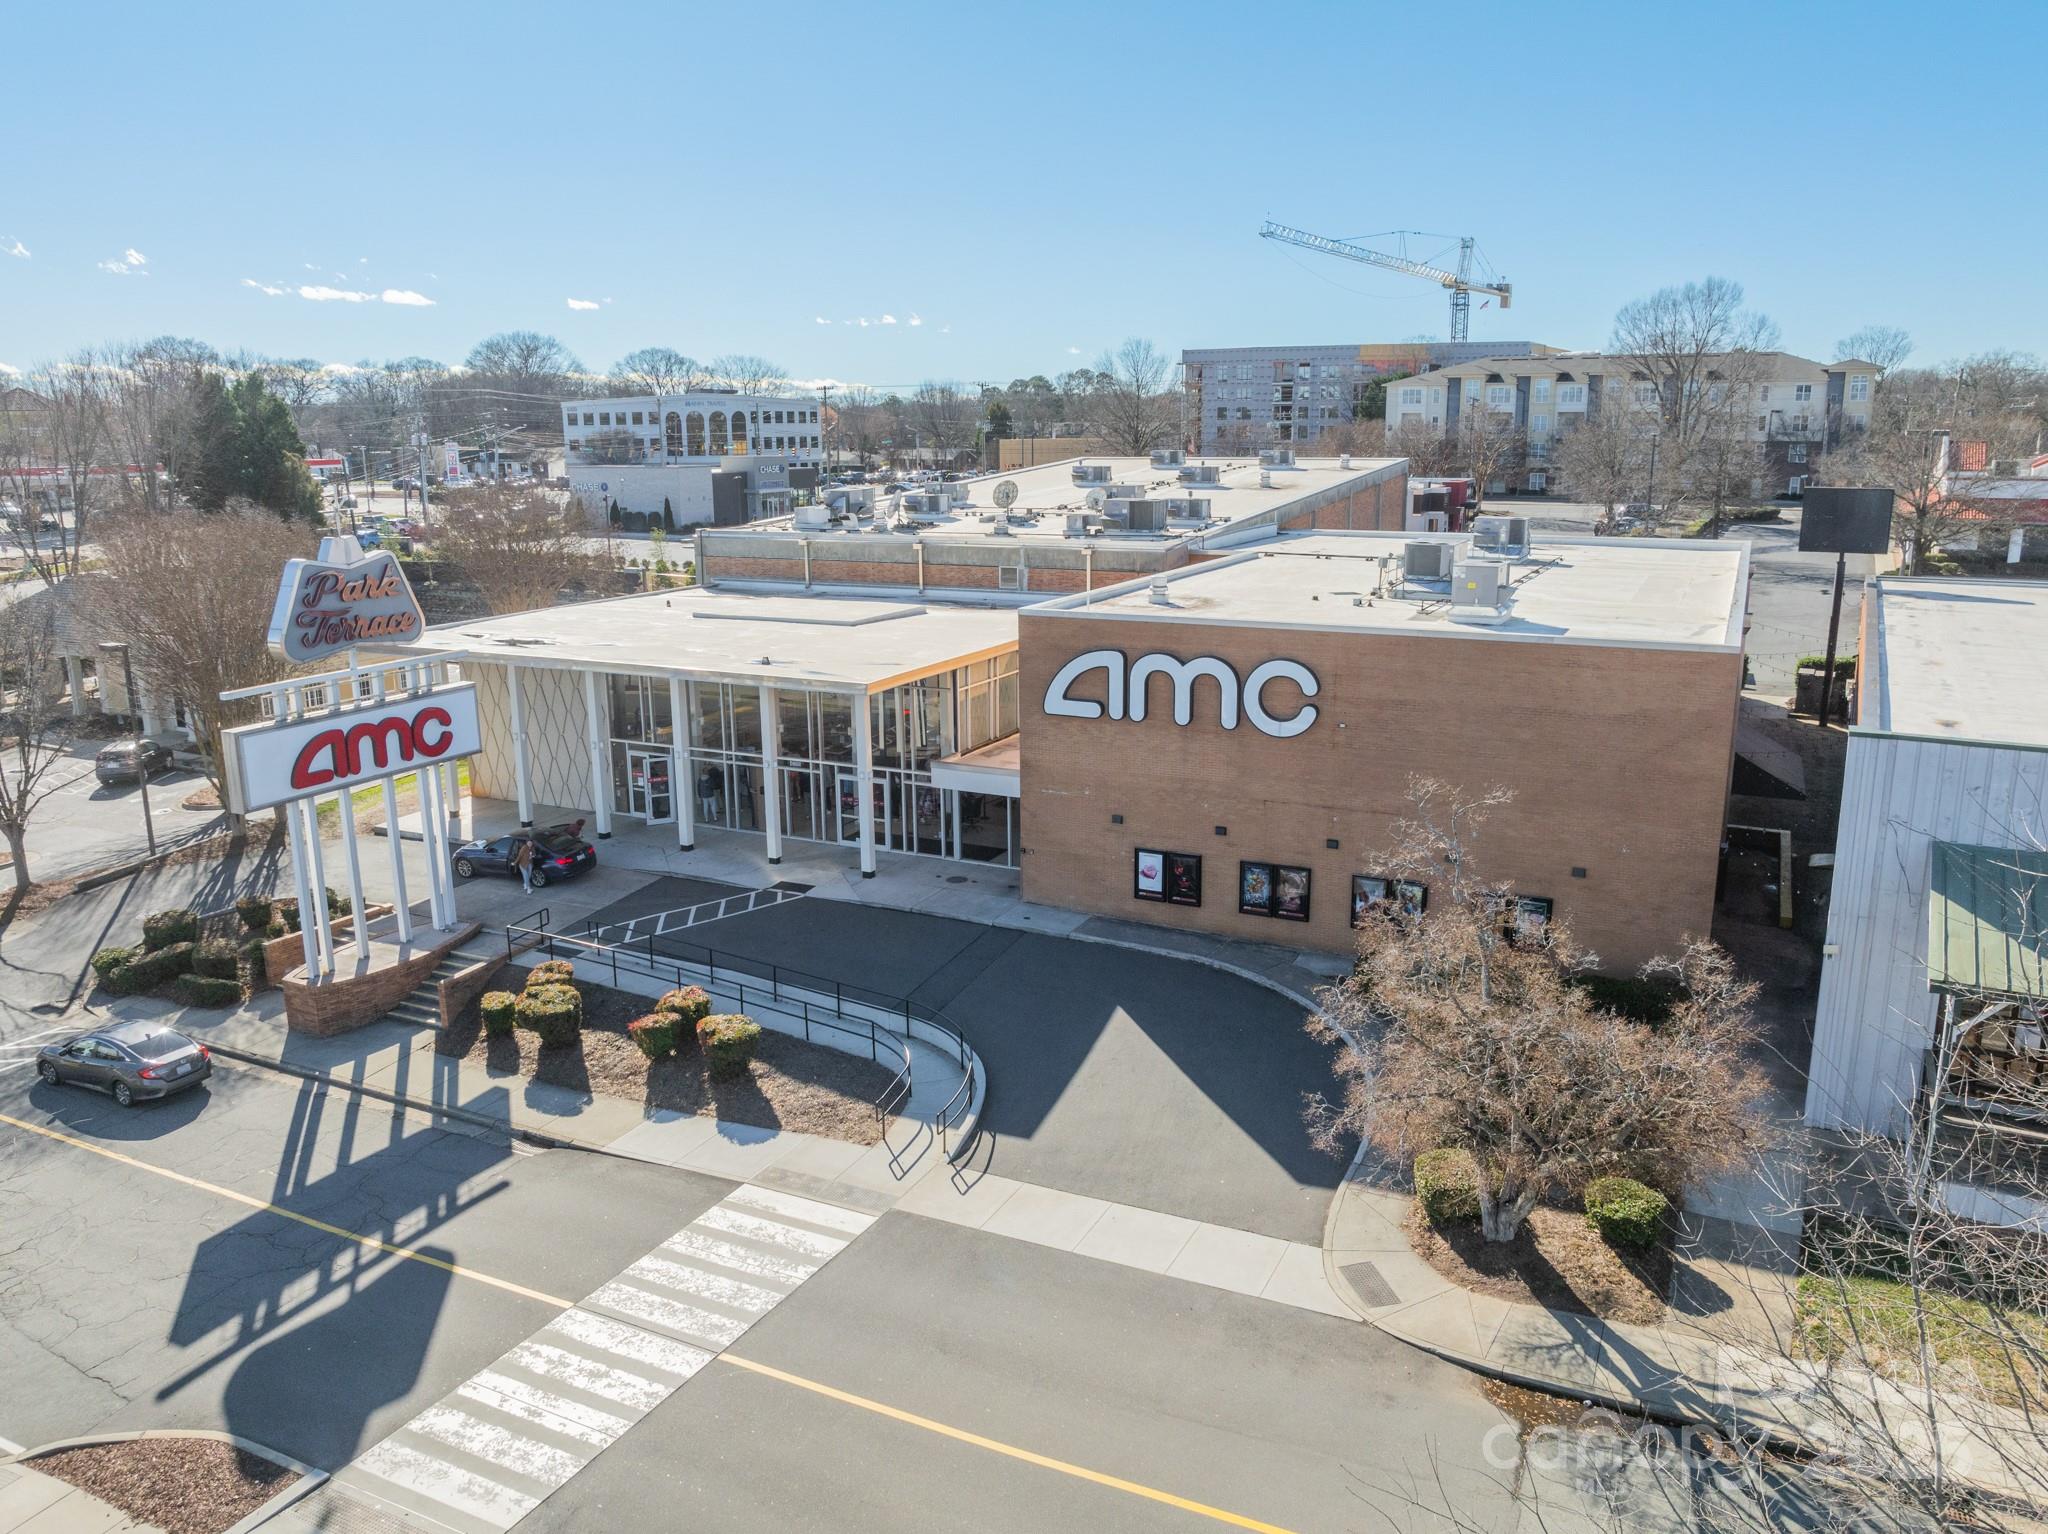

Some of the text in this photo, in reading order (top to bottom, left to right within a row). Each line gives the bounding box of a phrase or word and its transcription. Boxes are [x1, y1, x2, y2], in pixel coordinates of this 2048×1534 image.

[760, 465, 780, 473] CHASE
[303, 563, 404, 609] Park
[296, 606, 416, 649] Terrace
